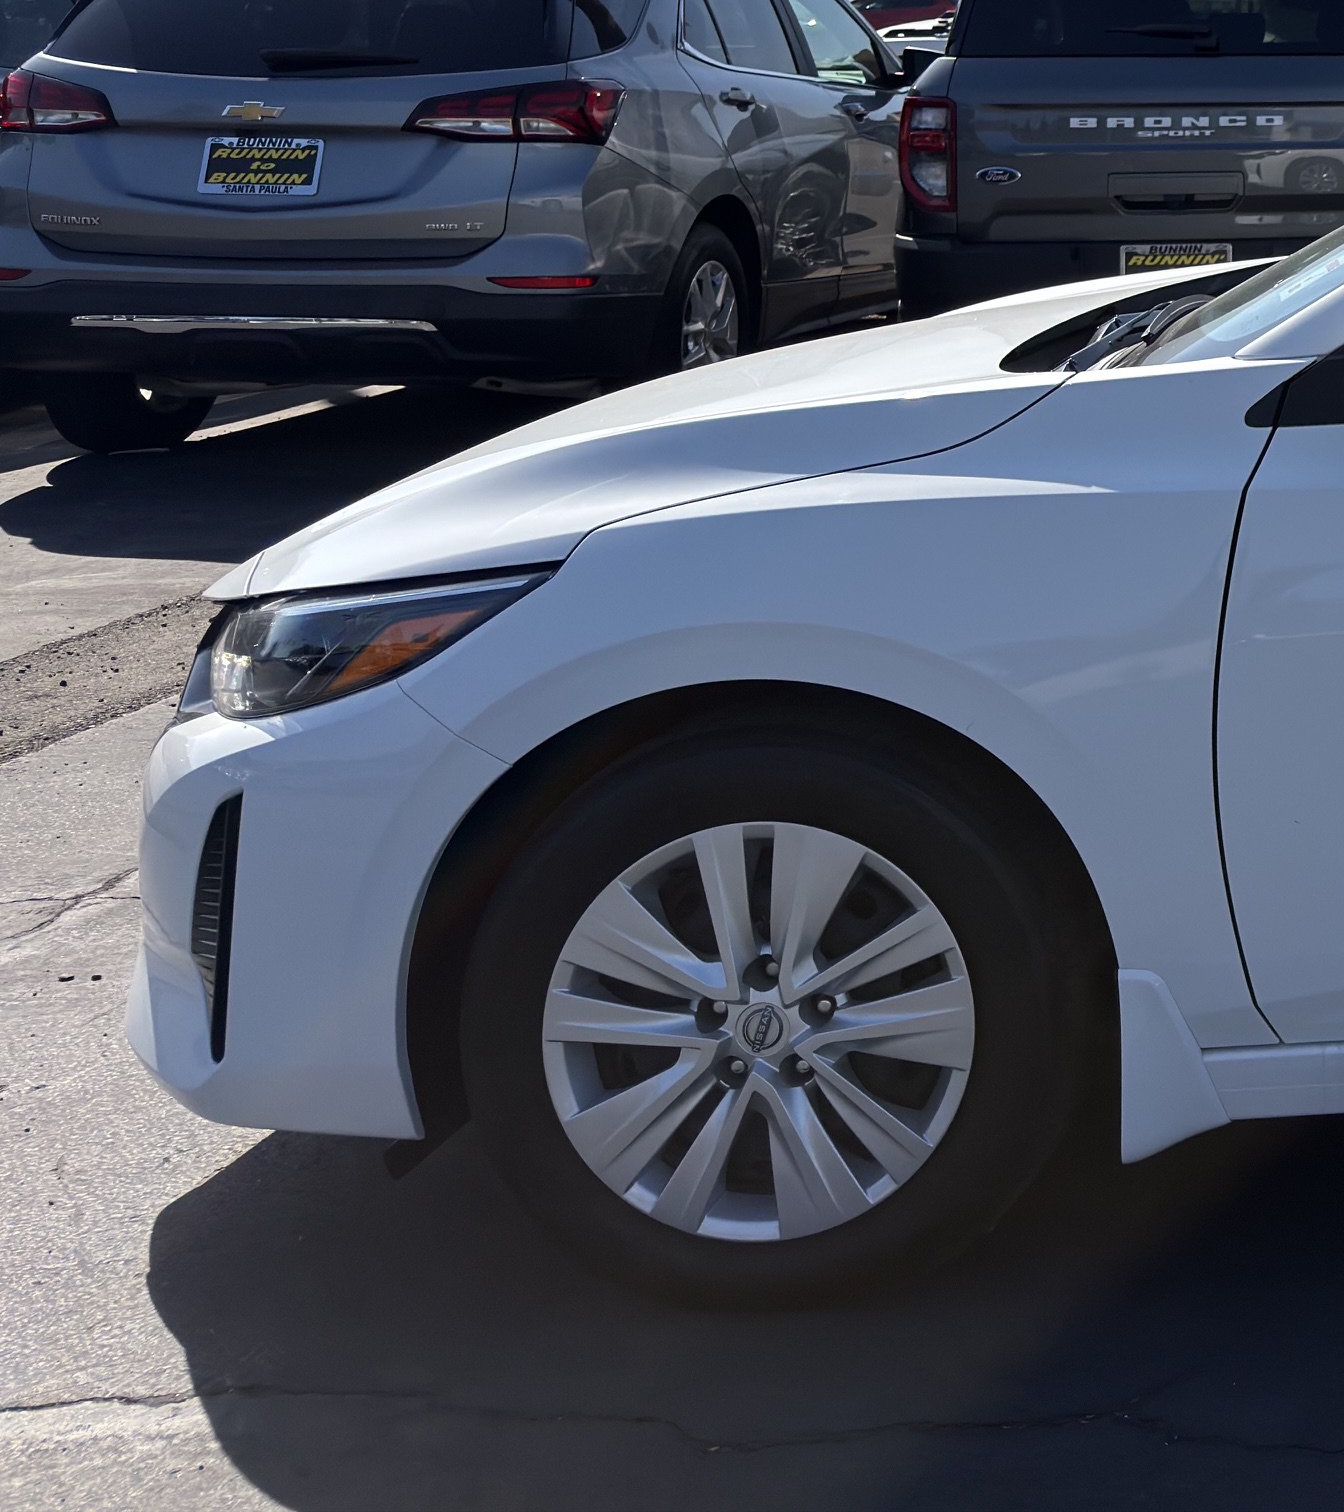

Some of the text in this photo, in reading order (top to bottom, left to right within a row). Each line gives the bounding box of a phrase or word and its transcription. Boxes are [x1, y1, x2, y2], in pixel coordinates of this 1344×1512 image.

[1069, 115, 1284, 128] BRONCO
[1136, 129, 1215, 138] SPORT
[237, 138, 295, 148] BUNNIN
[212, 148, 317, 160] RUNNIN'
[250, 161, 276, 169] to
[207, 172, 308, 184] BUNNIN
[985, 170, 1010, 181] Ford
[1149, 244, 1203, 254] BUNNIN
[1128, 254, 1226, 265] RUNNIN'
[753, 1007, 772, 1052] NISSAN
